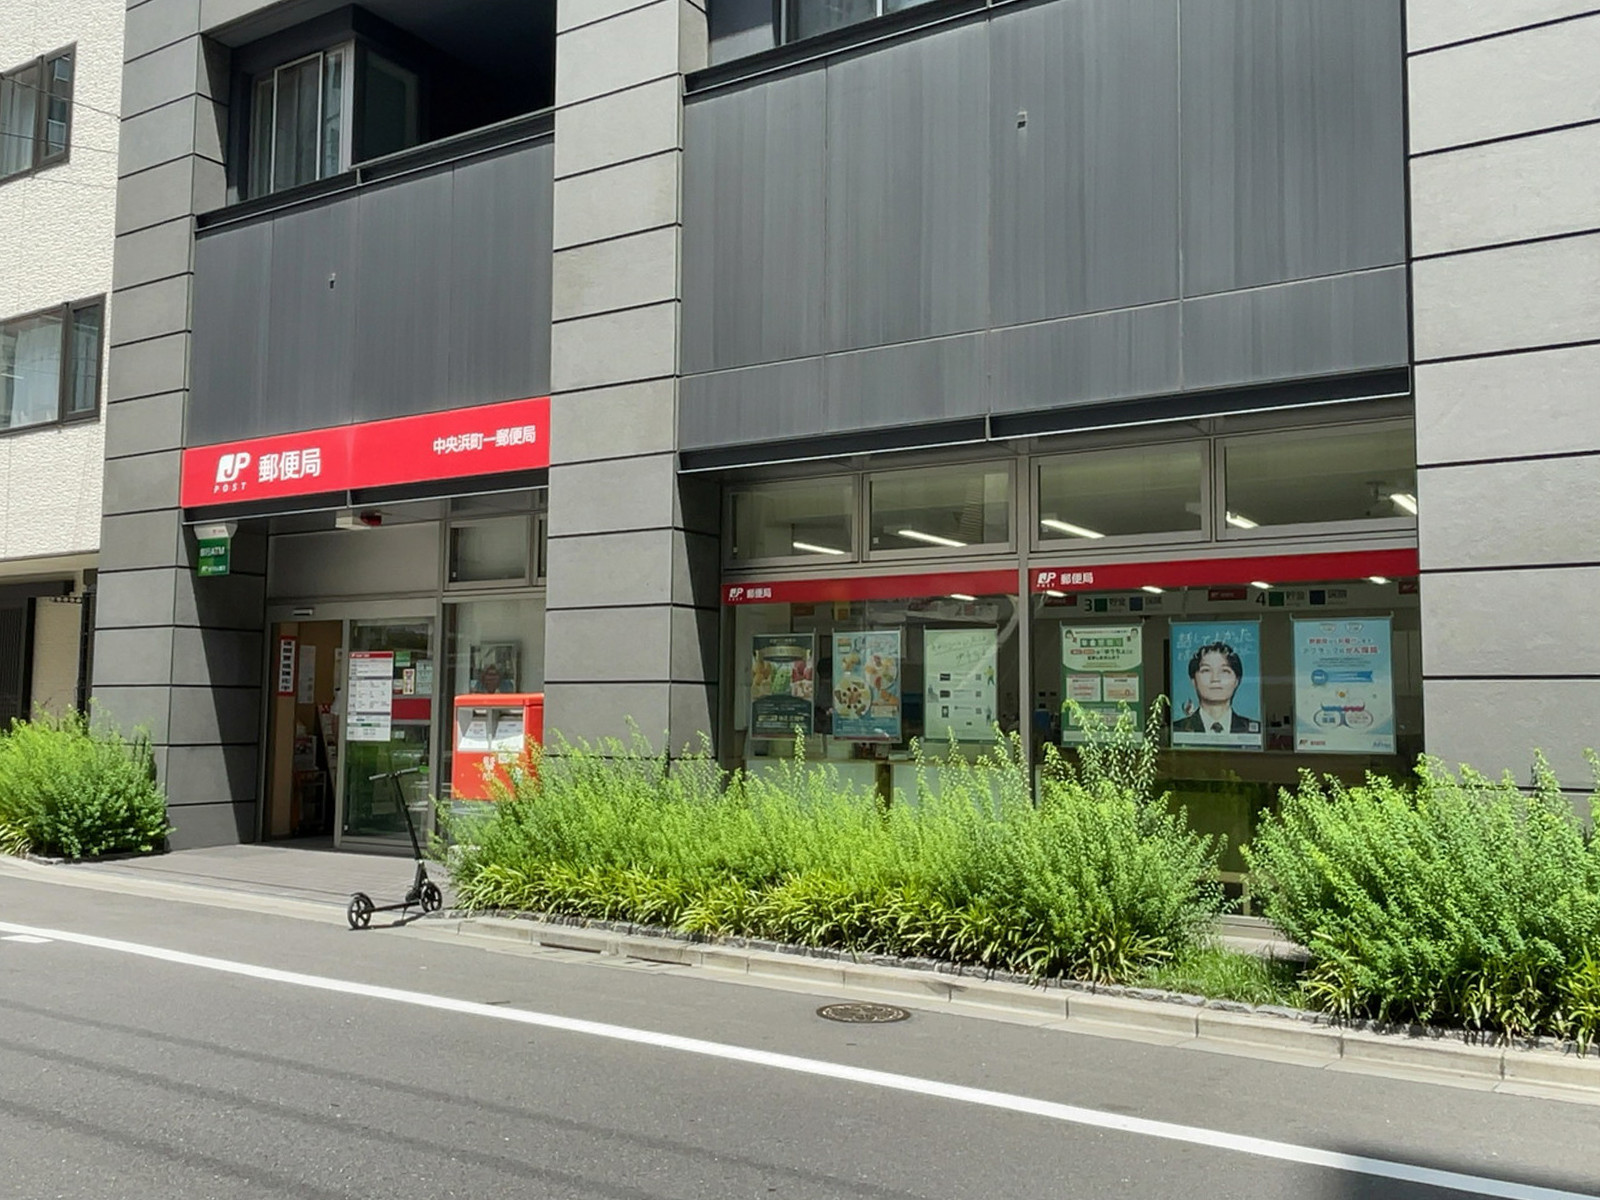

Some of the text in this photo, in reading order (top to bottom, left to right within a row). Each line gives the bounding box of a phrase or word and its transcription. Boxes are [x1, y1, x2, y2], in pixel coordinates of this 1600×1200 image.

[433, 425, 536, 455] 中央浜町一郵便局
[258, 448, 321, 483] 郵便局
[213, 482, 247, 494] POST
[1060, 572, 1094, 585] 郵便局
[747, 588, 772, 599] 郵便局
[1255, 591, 1266, 606] 4
[1084, 599, 1093, 612] 3
